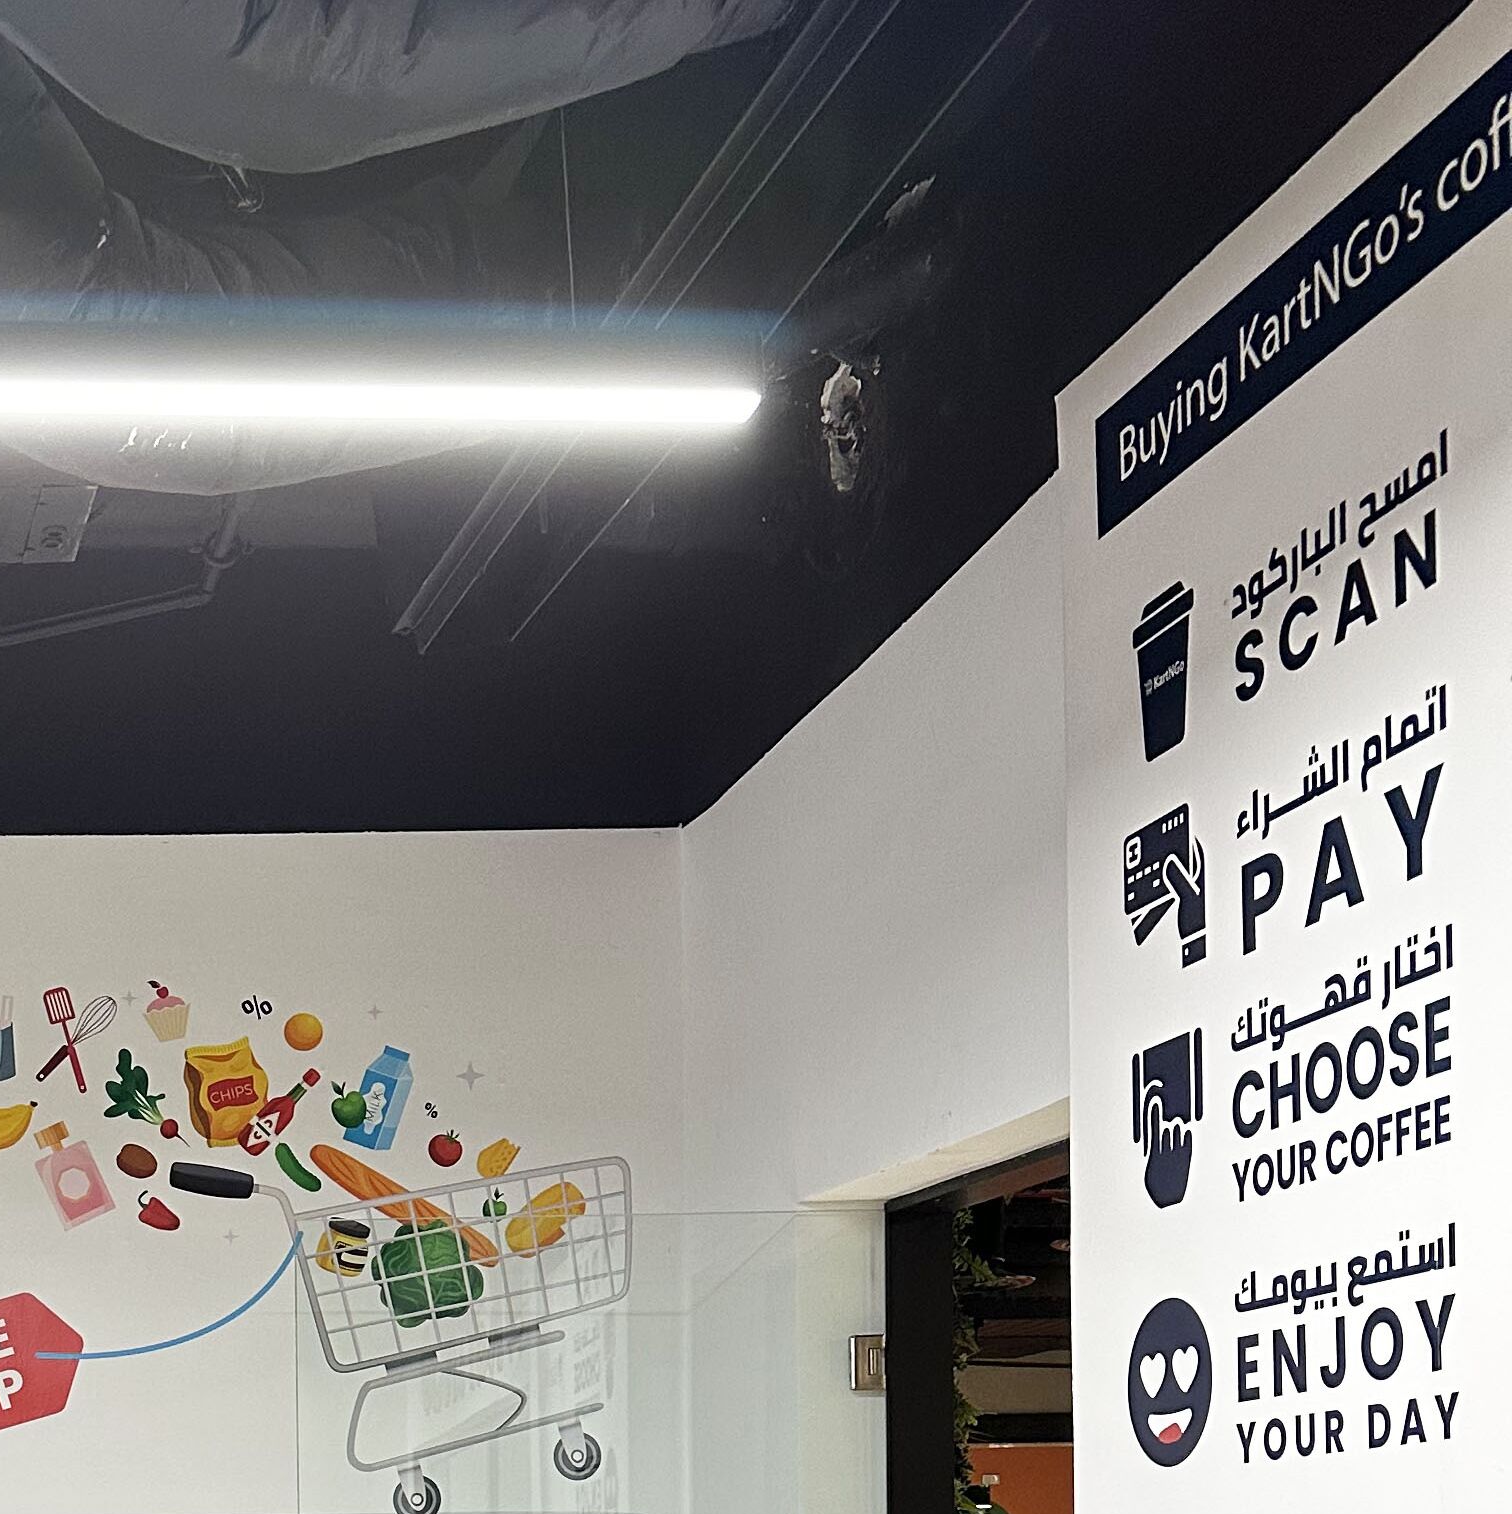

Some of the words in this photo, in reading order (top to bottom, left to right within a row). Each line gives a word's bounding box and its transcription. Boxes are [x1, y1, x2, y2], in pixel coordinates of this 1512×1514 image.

[1118, 355, 1229, 482] Buying
[1238, 183, 1426, 383] KartNGo's
[1357, 427, 1449, 549] امسح
[1231, 500, 1346, 620] الباركود
[1233, 507, 1438, 703] SCAN
[1360, 682, 1448, 793] اتمام
[1240, 761, 1445, 957] PAY
[1381, 923, 1454, 1010] اختار
[209, 1082, 254, 1104] CHIPS
[365, 1090, 384, 1122] MILK
[1231, 994, 1453, 1140] CHOOSE
[1231, 1139, 1318, 1203] YOUR
[1325, 1094, 1453, 1176] COFFEE
[1346, 1222, 1457, 1307] استمع
[1236, 1293, 1457, 1403] ENJOY
[1235, 1409, 1346, 1465] YOUR
[1367, 1390, 1460, 1450] DAY
